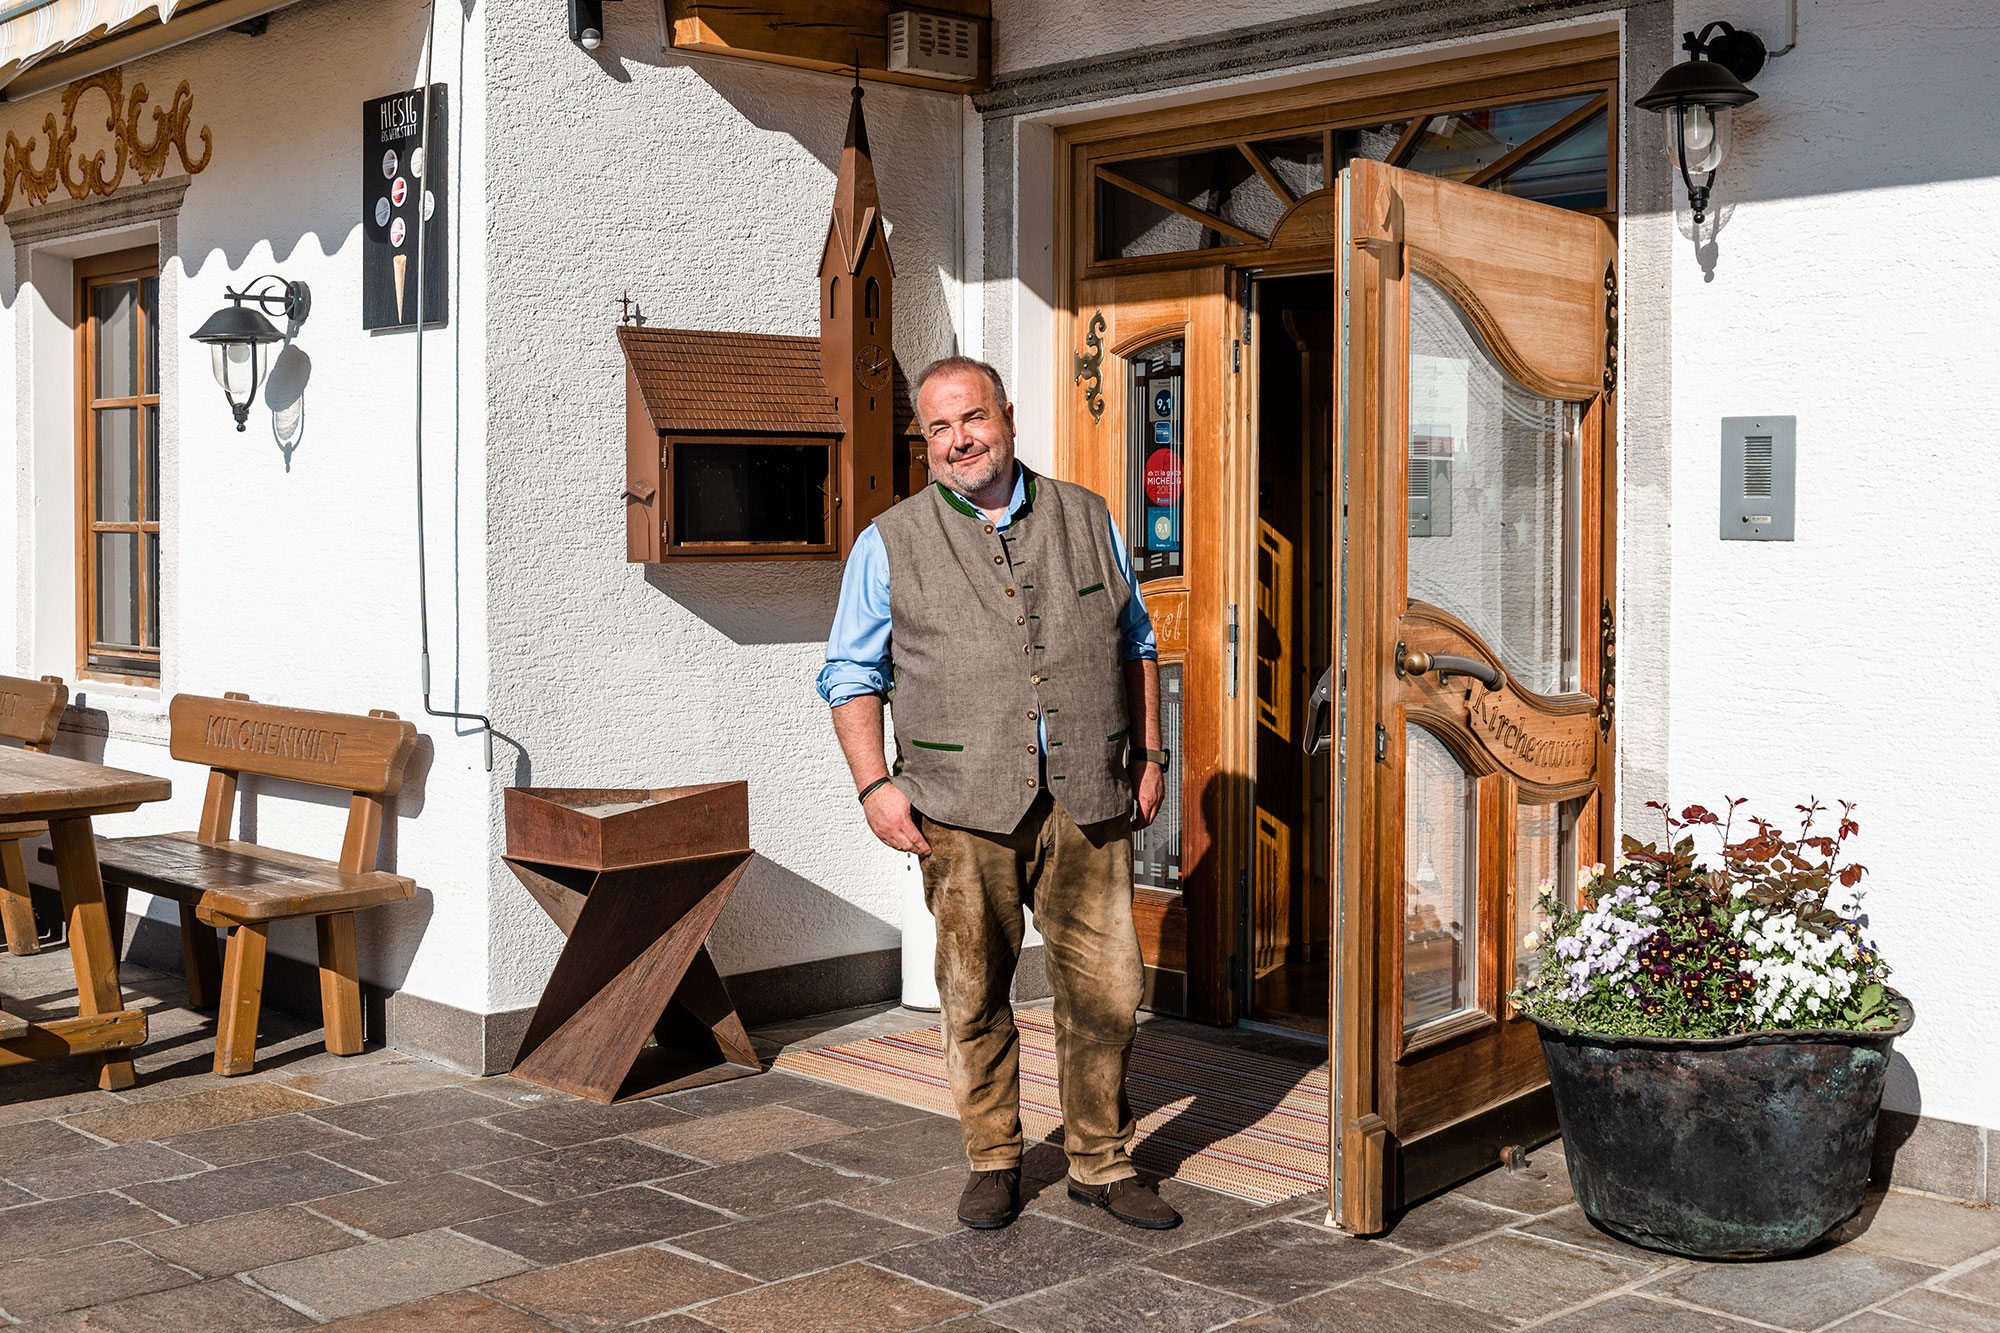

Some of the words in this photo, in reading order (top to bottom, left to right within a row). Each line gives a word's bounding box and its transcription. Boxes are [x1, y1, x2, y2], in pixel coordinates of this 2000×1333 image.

[381, 96, 417, 130] HIESIG
[1157, 398, 1172, 411] 9,1
[1147, 477, 1182, 485] MICHELN
[1157, 523, 1168, 534] 9,1
[1152, 601, 1184, 642] tel
[205, 714, 347, 765] KIRCHENWIRT
[1472, 684, 1590, 768] Kirchenwirt
